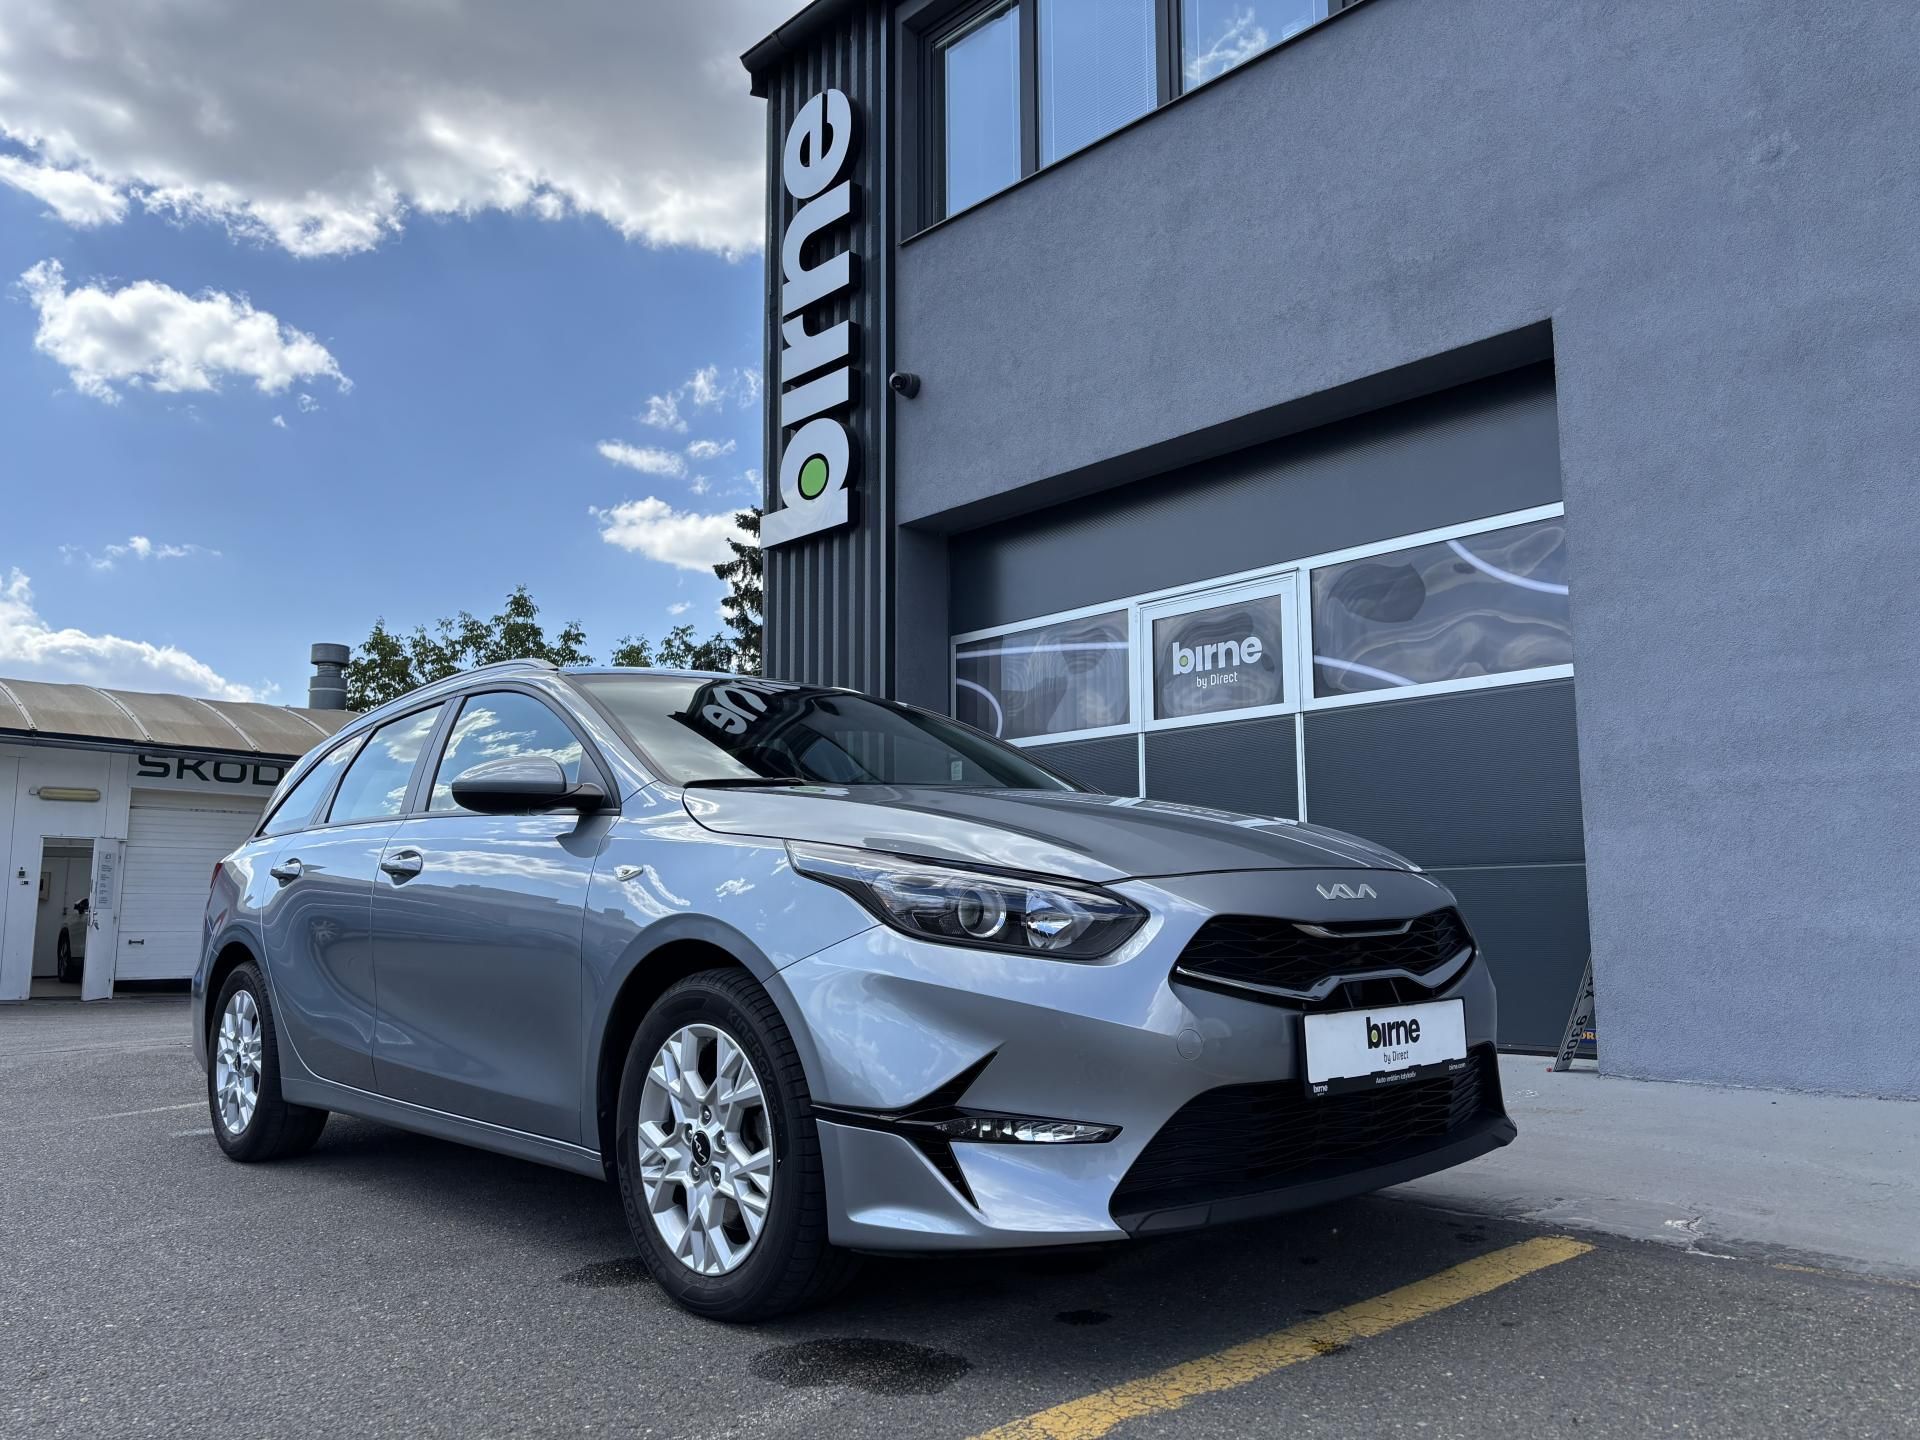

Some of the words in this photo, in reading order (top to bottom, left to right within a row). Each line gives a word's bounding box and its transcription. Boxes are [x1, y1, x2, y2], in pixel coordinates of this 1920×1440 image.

[759, 88, 851, 549] birne
[1172, 636, 1262, 676] birne
[1196, 676, 1207, 689] by
[1210, 672, 1238, 686] Direct
[137, 754, 284, 786] SKOD
[1366, 1016, 1421, 1049] birne
[1383, 1052, 1391, 1064] by
[1392, 1050, 1409, 1061] Direct
